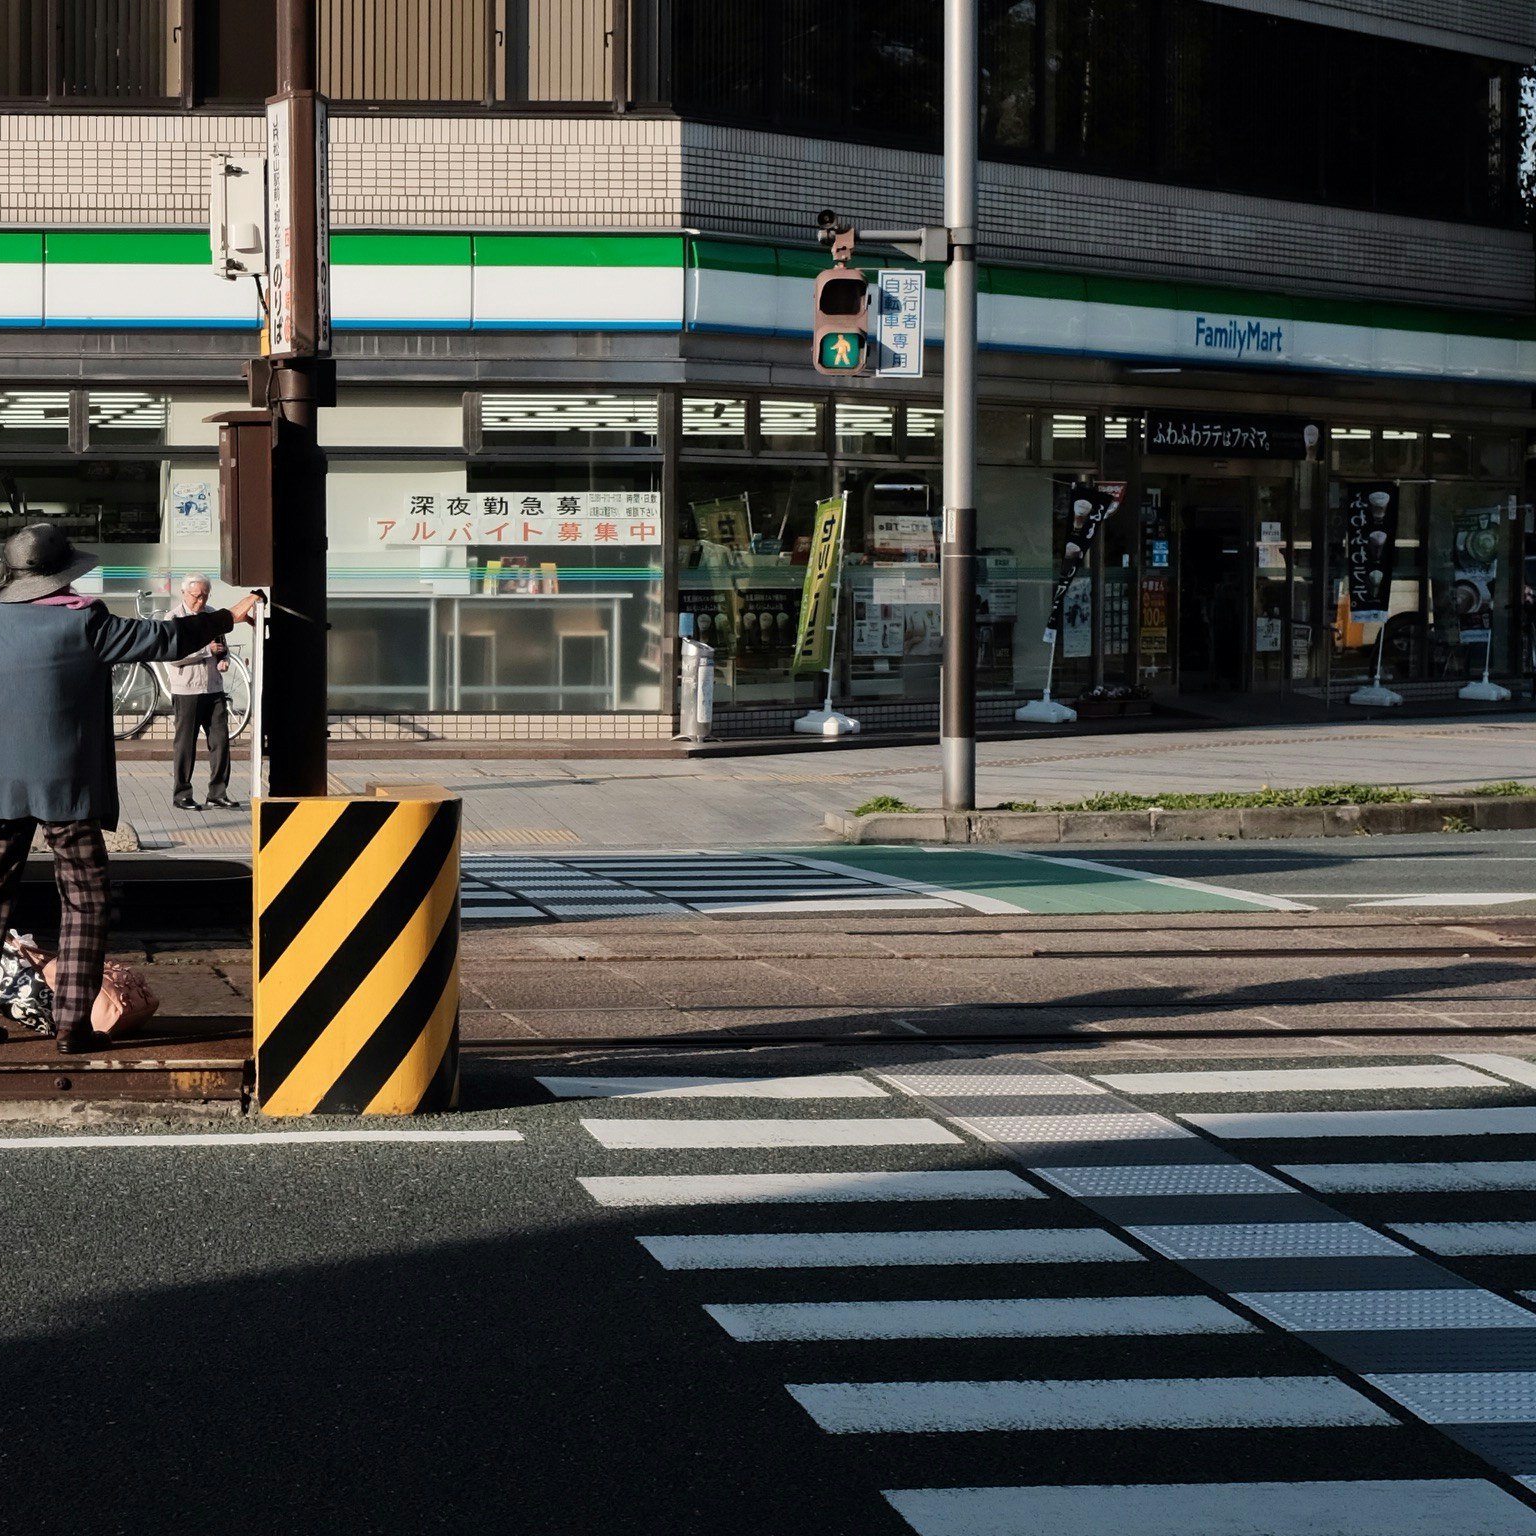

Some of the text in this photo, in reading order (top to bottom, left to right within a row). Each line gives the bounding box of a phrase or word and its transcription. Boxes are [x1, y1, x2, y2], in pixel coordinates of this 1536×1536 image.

[884, 279, 900, 329] 自転車
[903, 278, 919, 329] 歩行者
[893, 333, 909, 368] 専用
[1195, 317, 1282, 358] FamilyMart
[1153, 421, 1270, 451] ふわふわラテはファミマ。
[410, 495, 581, 516] 深夜勤急募
[376, 519, 657, 543] アルバイト募集中
